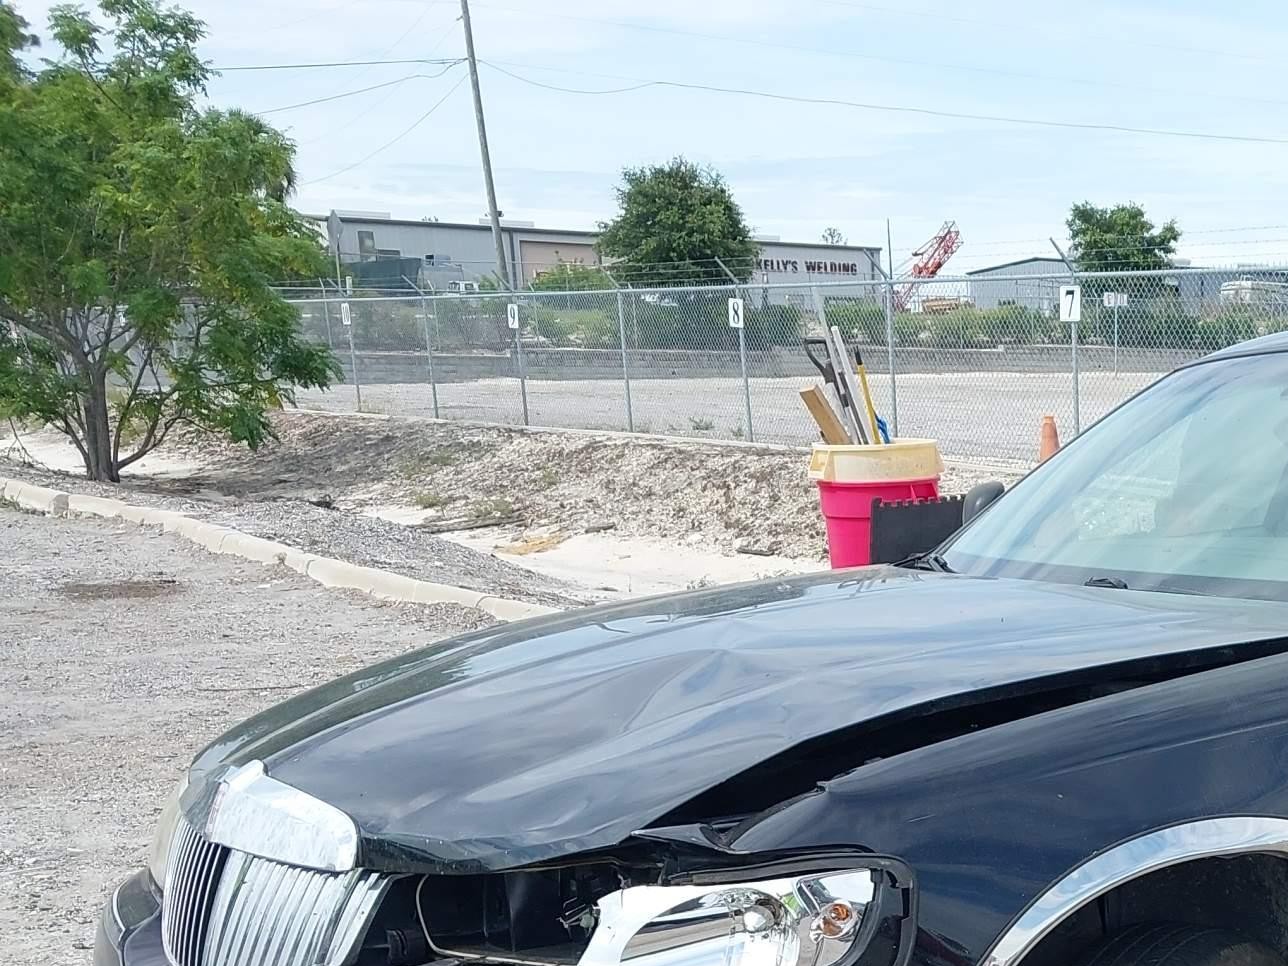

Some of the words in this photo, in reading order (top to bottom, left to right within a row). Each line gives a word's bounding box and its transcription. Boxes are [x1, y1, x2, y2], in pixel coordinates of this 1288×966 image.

[804, 261, 858, 276] WELDING
[732, 301, 740, 325] 8
[1064, 289, 1075, 318] 7
[509, 305, 516, 327] 9
